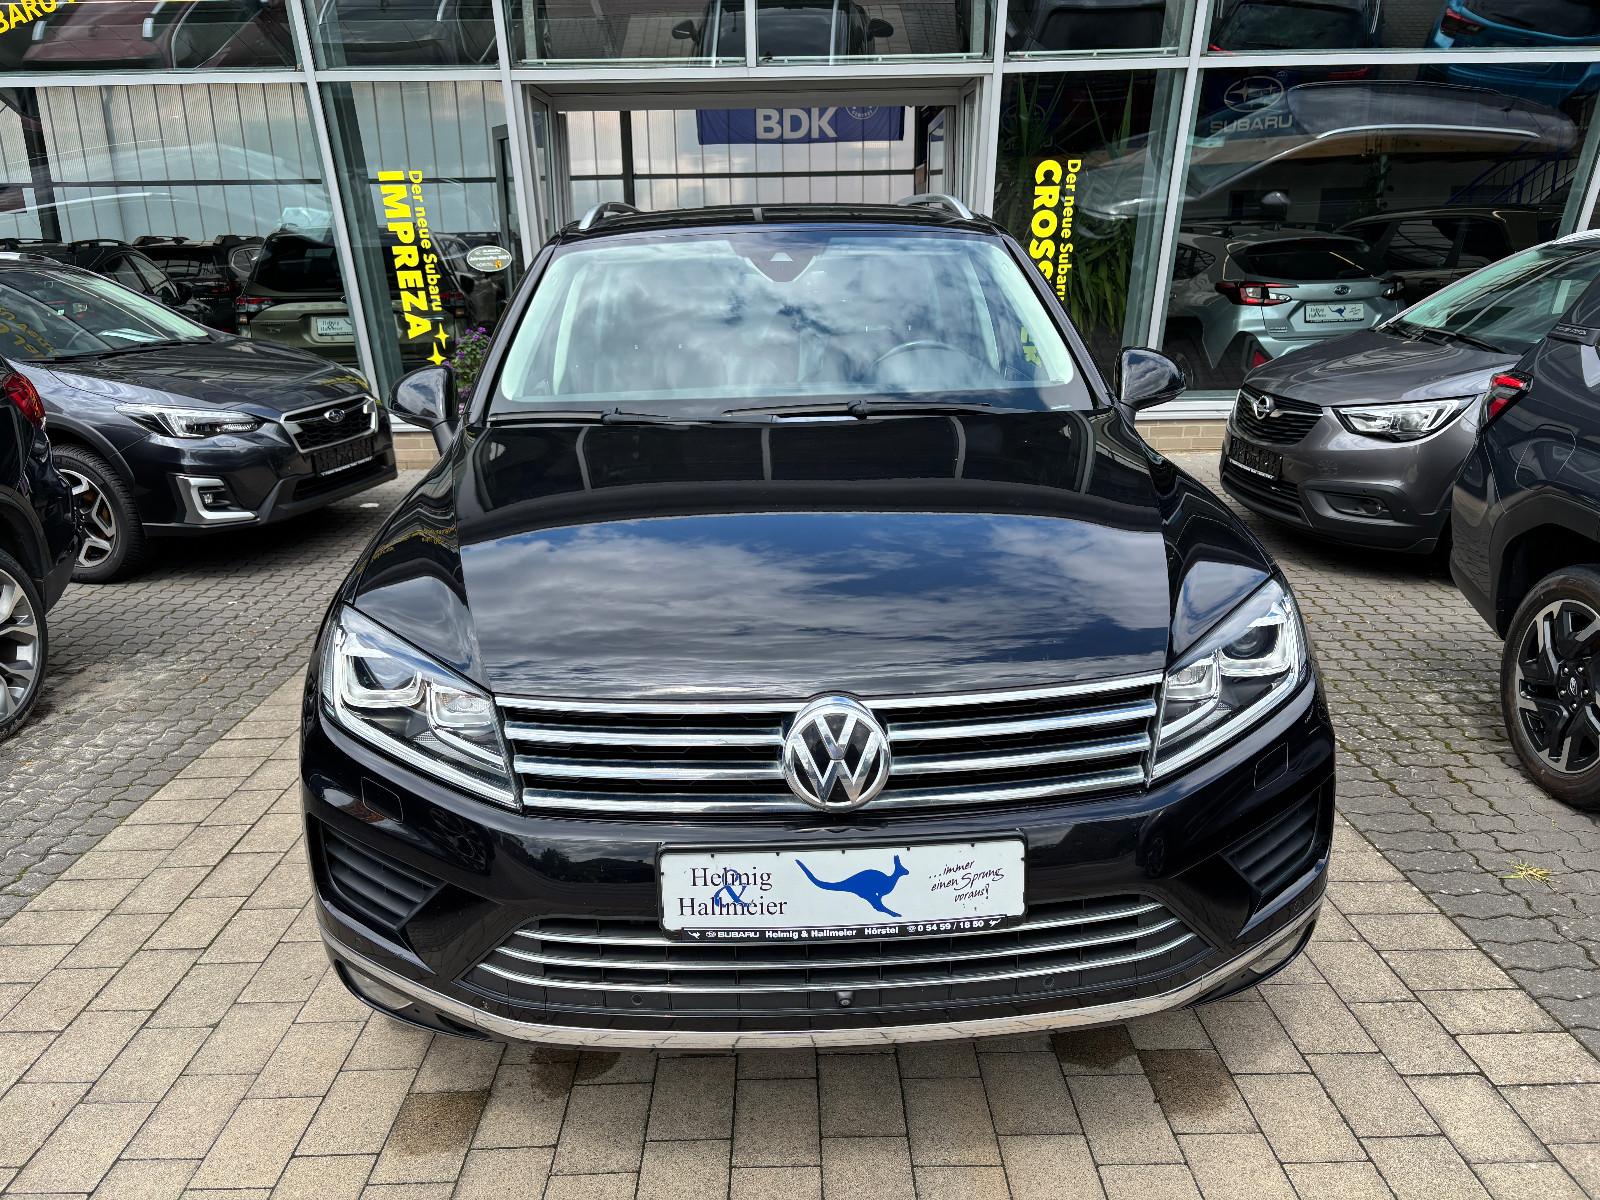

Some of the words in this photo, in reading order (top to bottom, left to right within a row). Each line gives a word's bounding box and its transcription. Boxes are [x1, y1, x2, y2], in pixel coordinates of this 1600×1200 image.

[755, 106, 838, 140] BDK
[1210, 114, 1293, 133] SUBARU
[408, 170, 424, 203] Der
[1065, 159, 1082, 192] Der
[414, 206, 432, 249] neue
[1060, 195, 1075, 239] neue
[377, 170, 432, 340] IMPREZA
[423, 253, 443, 312] Subaru
[689, 866, 773, 892] Helmig
[930, 878, 959, 892] einen
[953, 867, 1005, 891] Sprung
[677, 895, 788, 916] Hallmeier
[765, 930, 798, 939] Helmig
[801, 930, 808, 938] &
[811, 929, 857, 938] Hallmeier
[864, 926, 899, 936] Hörstel
[926, 924, 938, 932] 54
[939, 923, 951, 931] 59
[959, 921, 971, 929] 18
[972, 920, 985, 928] 50
